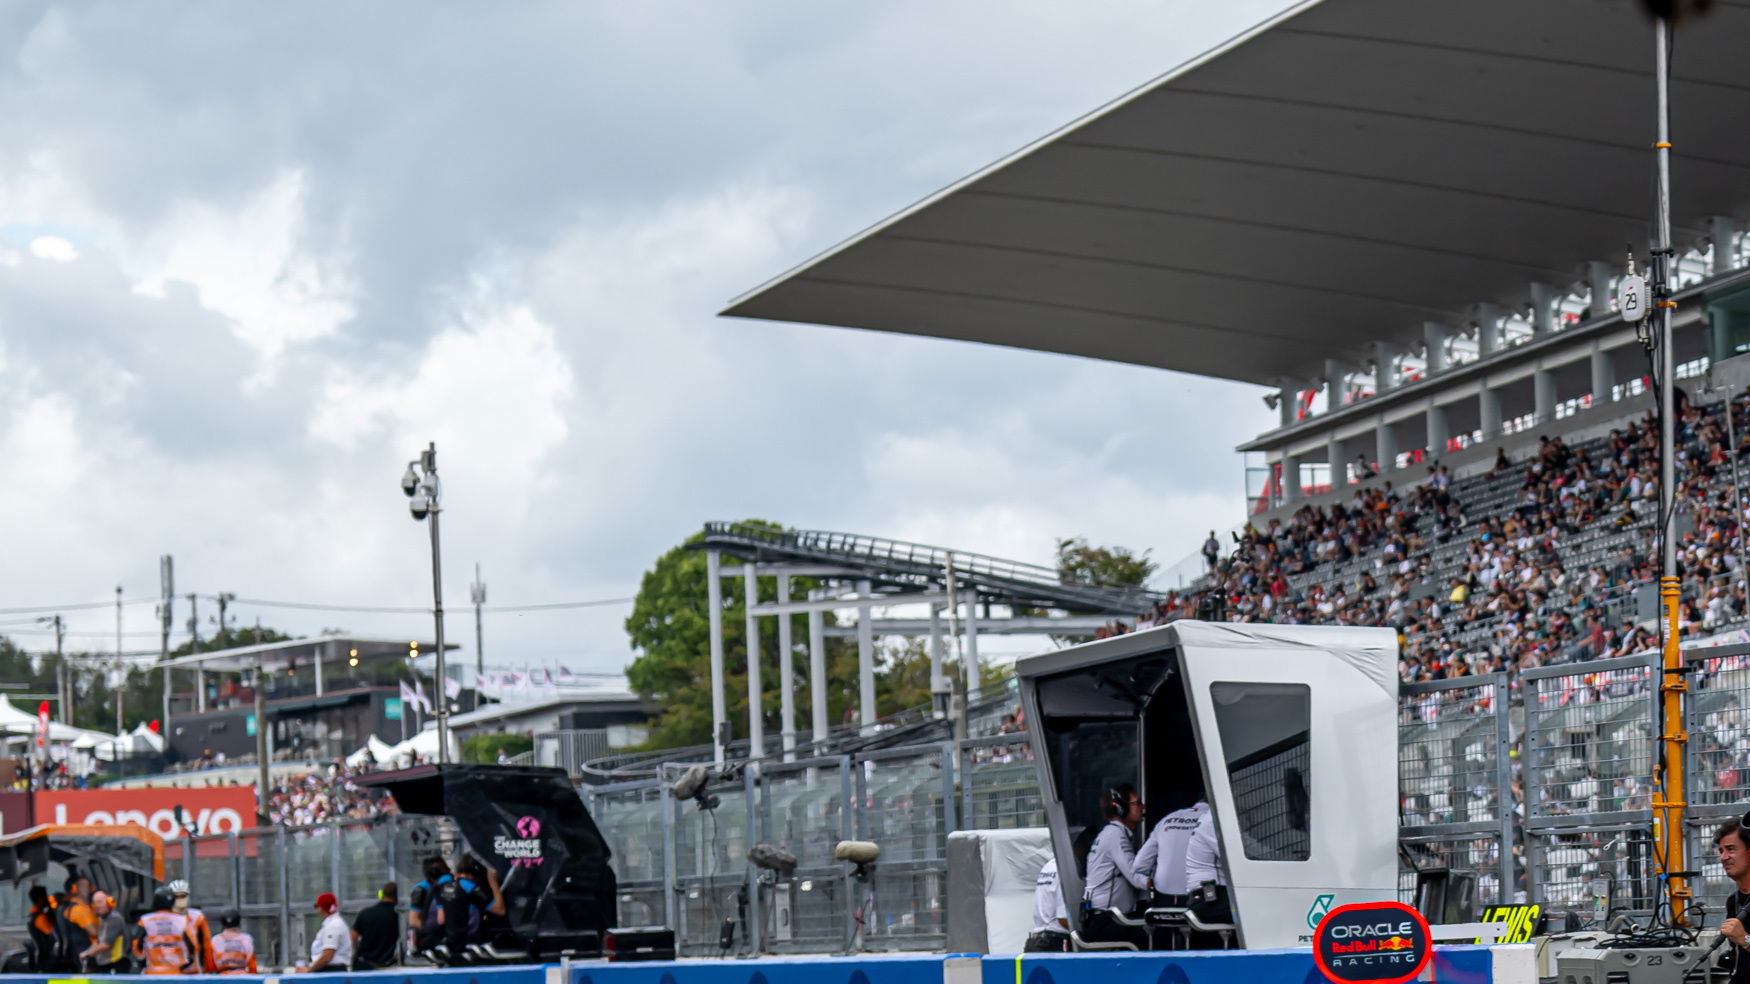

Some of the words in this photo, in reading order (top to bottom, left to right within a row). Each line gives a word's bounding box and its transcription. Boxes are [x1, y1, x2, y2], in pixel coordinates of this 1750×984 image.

[1331, 921, 1413, 938] ORACLE
[1331, 941, 1355, 953] Red
[1356, 940, 1377, 951] Bull
[1332, 954, 1415, 967] RACING
[1647, 955, 1662, 966] 23
